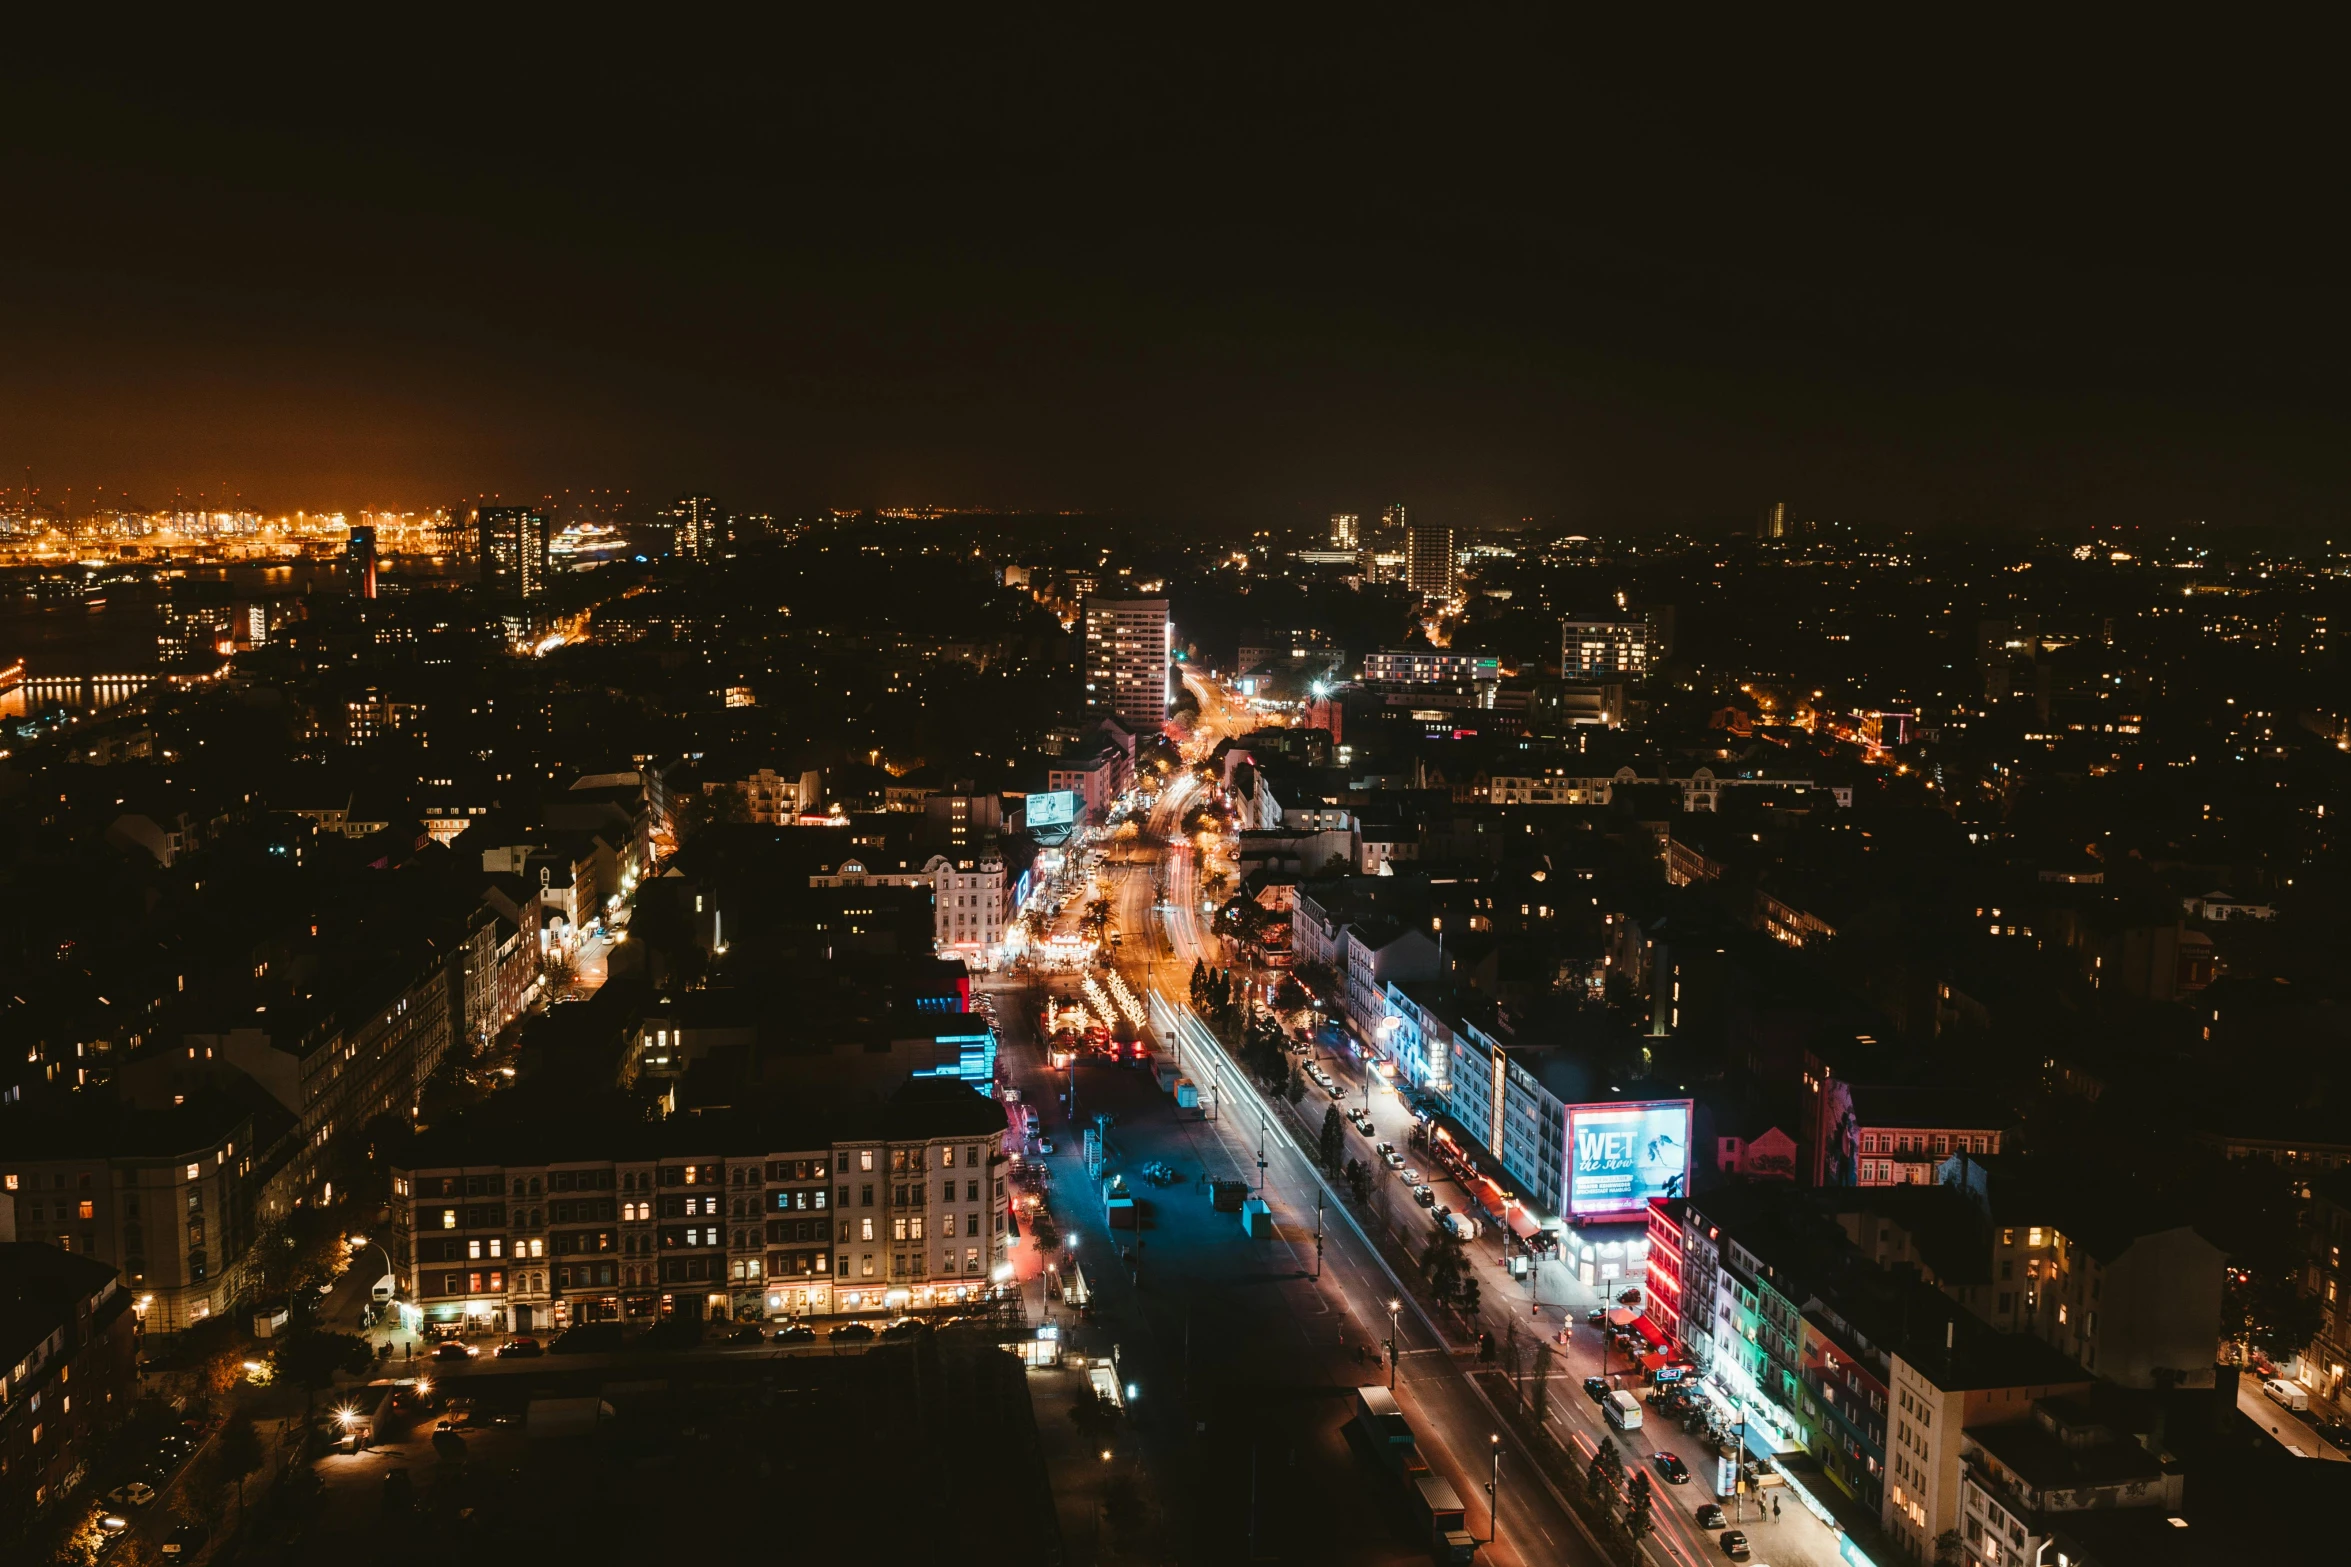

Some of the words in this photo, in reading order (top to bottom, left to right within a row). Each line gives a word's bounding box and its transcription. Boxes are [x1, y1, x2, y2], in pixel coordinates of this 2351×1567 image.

[1578, 1131, 1638, 1160] WET
[1579, 1154, 1601, 1171] the
[1602, 1156, 1635, 1169] show
